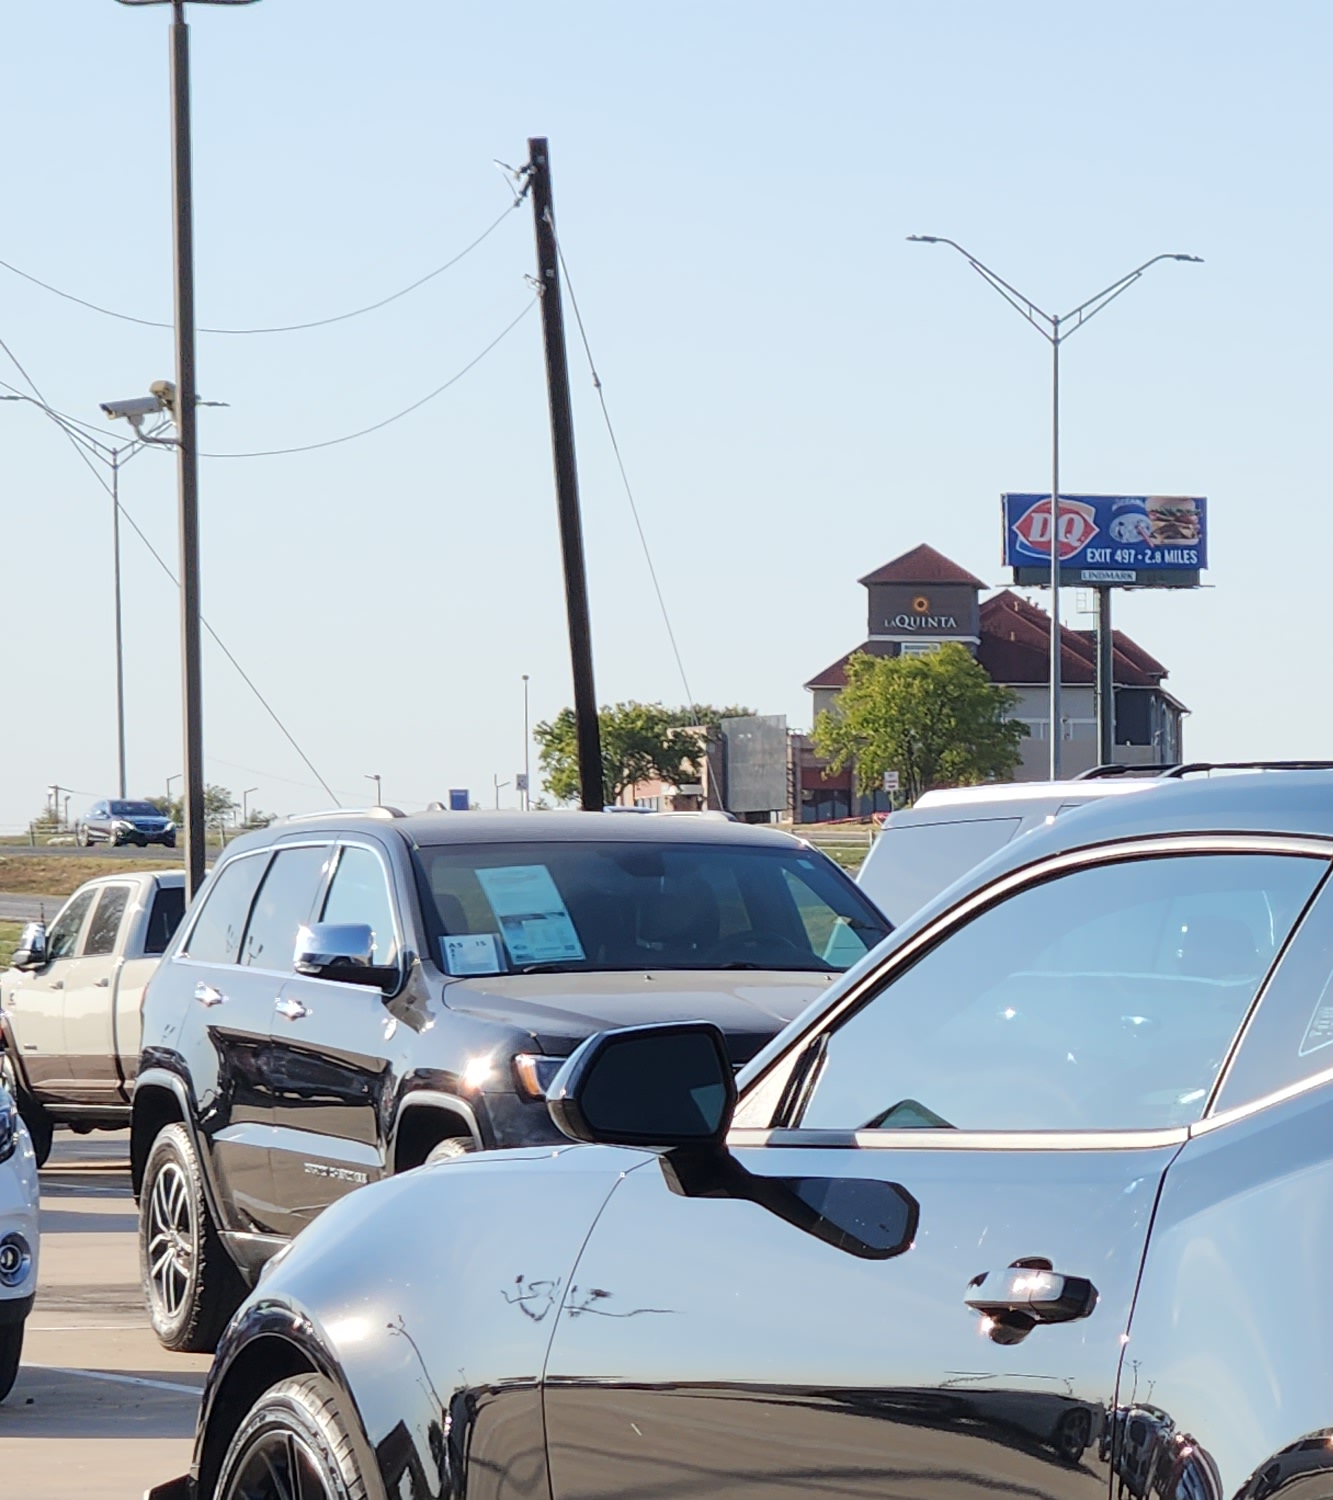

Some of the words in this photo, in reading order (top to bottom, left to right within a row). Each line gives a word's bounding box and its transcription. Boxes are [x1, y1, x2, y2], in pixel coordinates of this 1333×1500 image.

[1029, 513, 1085, 547] DQ
[1086, 548, 1110, 564] EXIT
[1115, 549, 1135, 564] 497
[1144, 549, 1160, 564] 2.8
[1164, 550, 1198, 564] MILES
[884, 619, 896, 627] LA
[895, 614, 957, 631] QUINTA
